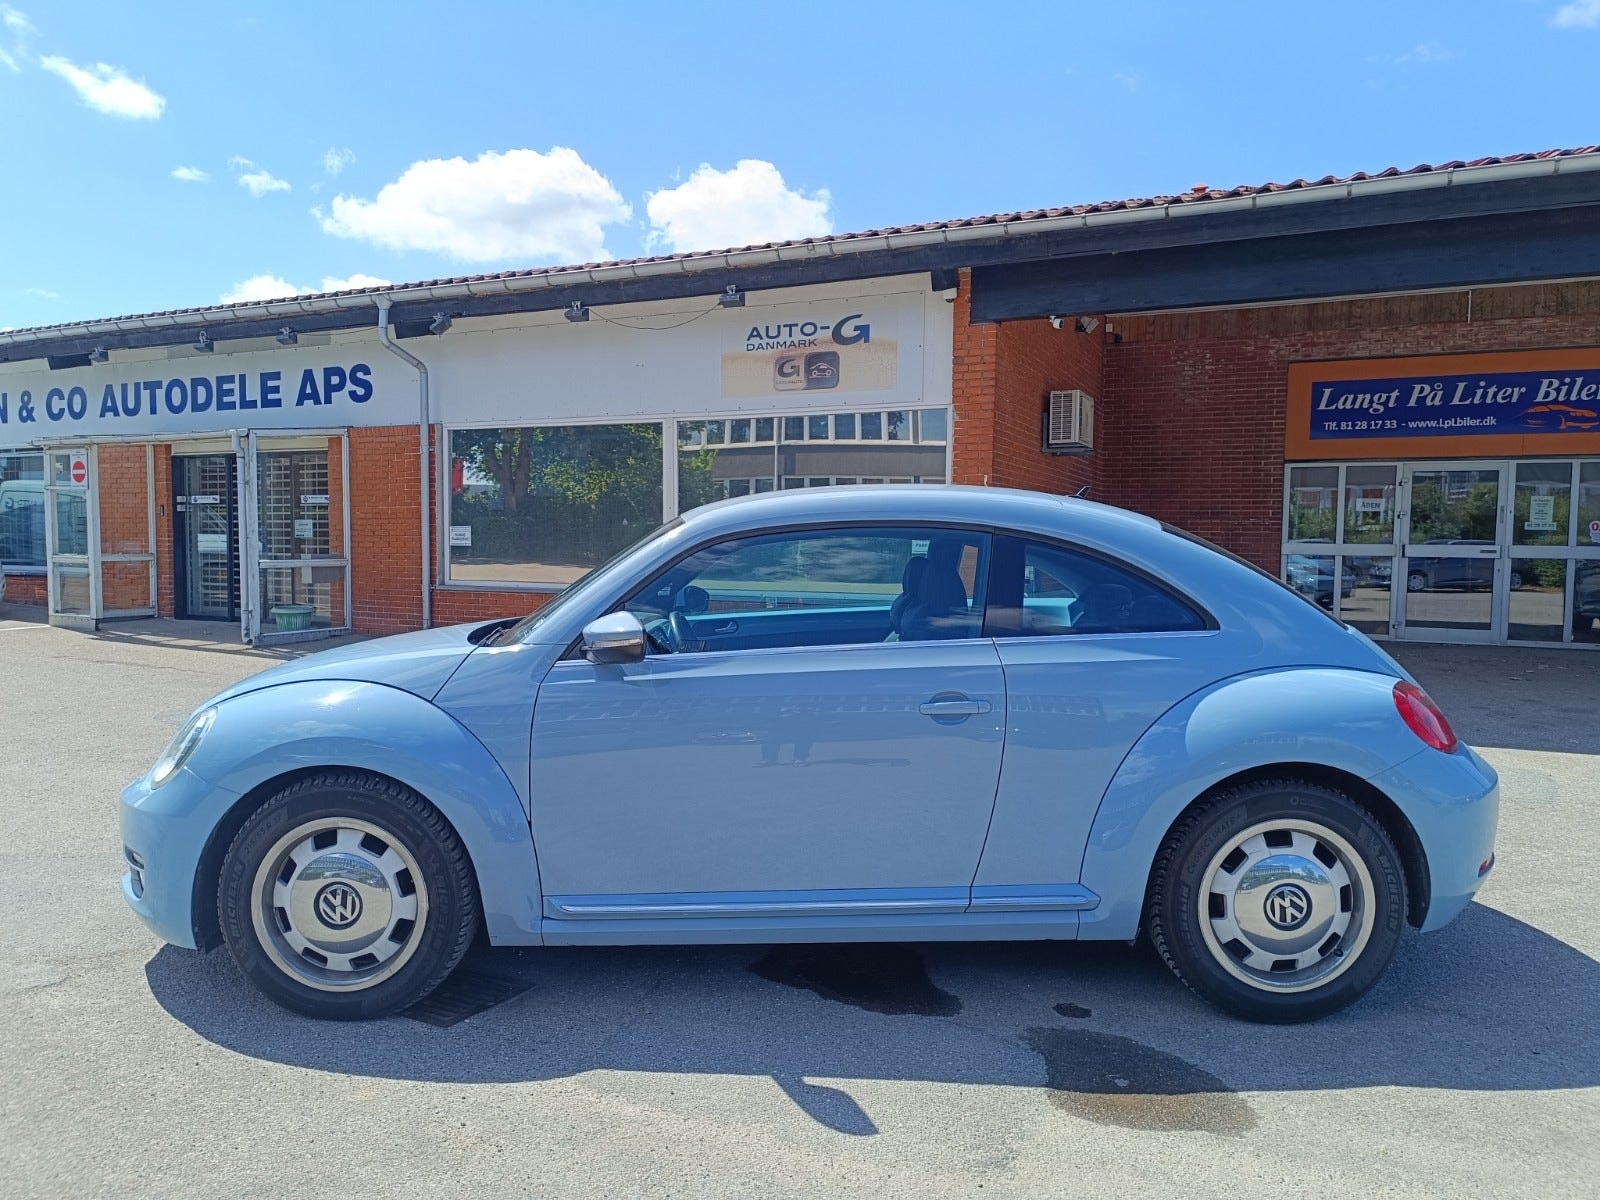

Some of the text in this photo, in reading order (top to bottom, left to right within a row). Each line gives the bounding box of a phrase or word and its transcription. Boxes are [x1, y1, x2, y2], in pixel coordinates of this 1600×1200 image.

[746, 338, 818, 352] DANMARK
[18, 390, 36, 424] &
[46, 387, 87, 421] CO
[99, 371, 282, 418] AUTODELE
[295, 363, 374, 407] APS
[1317, 388, 1400, 414] Langt
[1406, 382, 1444, 407] På
[1450, 380, 1527, 406] Liter
[1323, 421, 1339, 431] Tlf.
[1340, 421, 1353, 430] 81
[1354, 421, 1368, 430] 28
[1369, 420, 1382, 429] 17
[1384, 420, 1397, 429] 33
[227, 861, 245, 938] MICHELIN
[1378, 855, 1399, 932] MICHELIN
